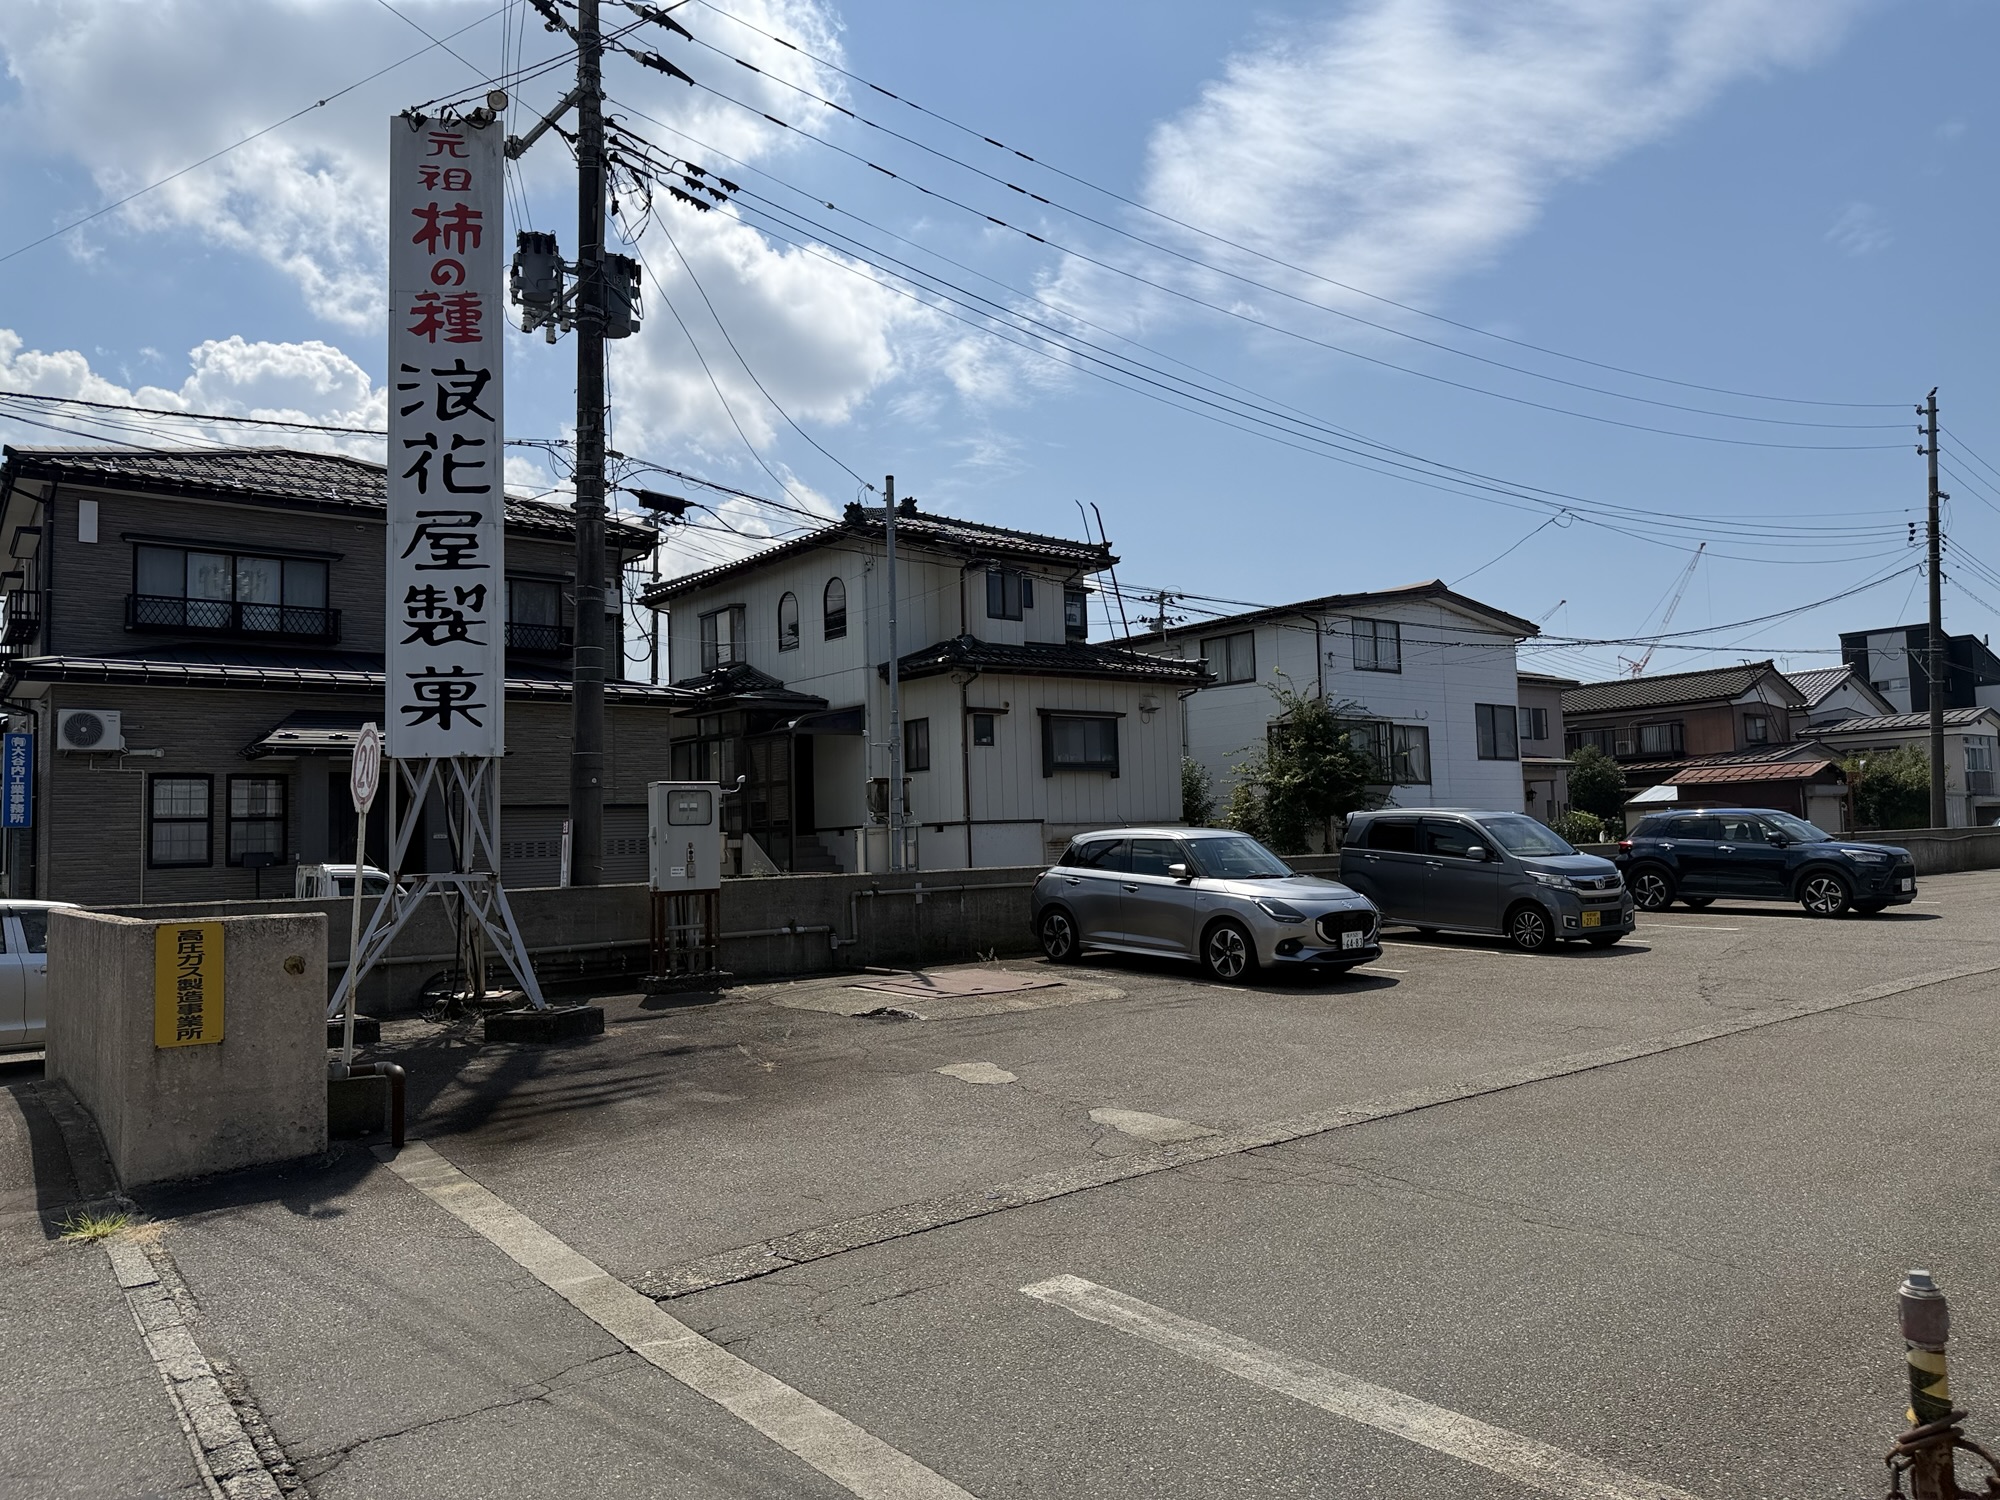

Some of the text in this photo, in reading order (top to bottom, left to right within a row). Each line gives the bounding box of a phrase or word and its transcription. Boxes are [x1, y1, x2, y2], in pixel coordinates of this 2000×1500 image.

[357, 744, 375, 789] 20
[176, 929, 206, 1042] 高圧ガス製造事業所
